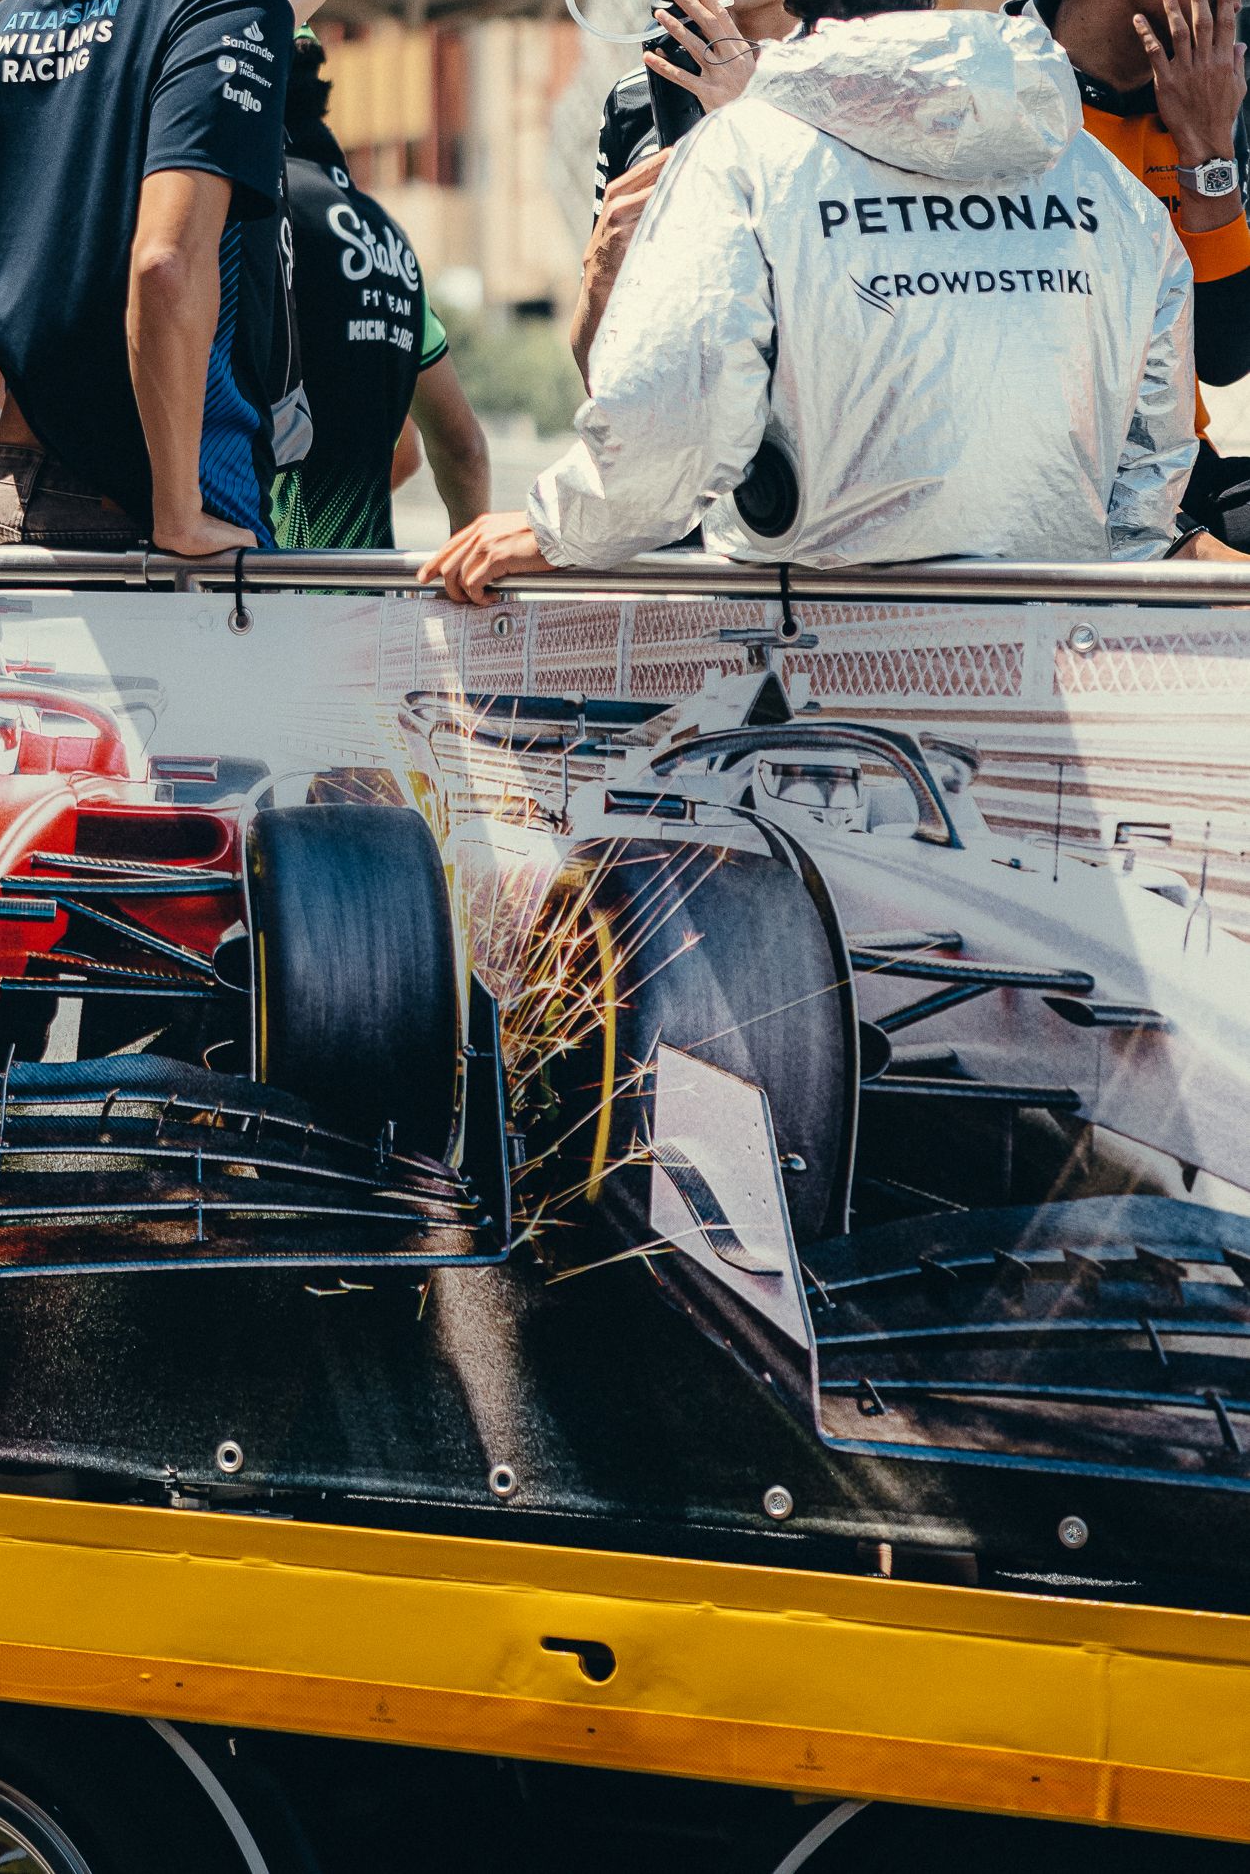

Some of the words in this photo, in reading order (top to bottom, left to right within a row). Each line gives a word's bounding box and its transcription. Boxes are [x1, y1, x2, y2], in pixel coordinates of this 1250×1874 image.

[2, 47, 90, 83] RACING
[221, 34, 275, 63] Santander
[818, 194, 1100, 239] PETRONAS
[326, 203, 419, 292] Stake
[348, 320, 387, 341] KICK
